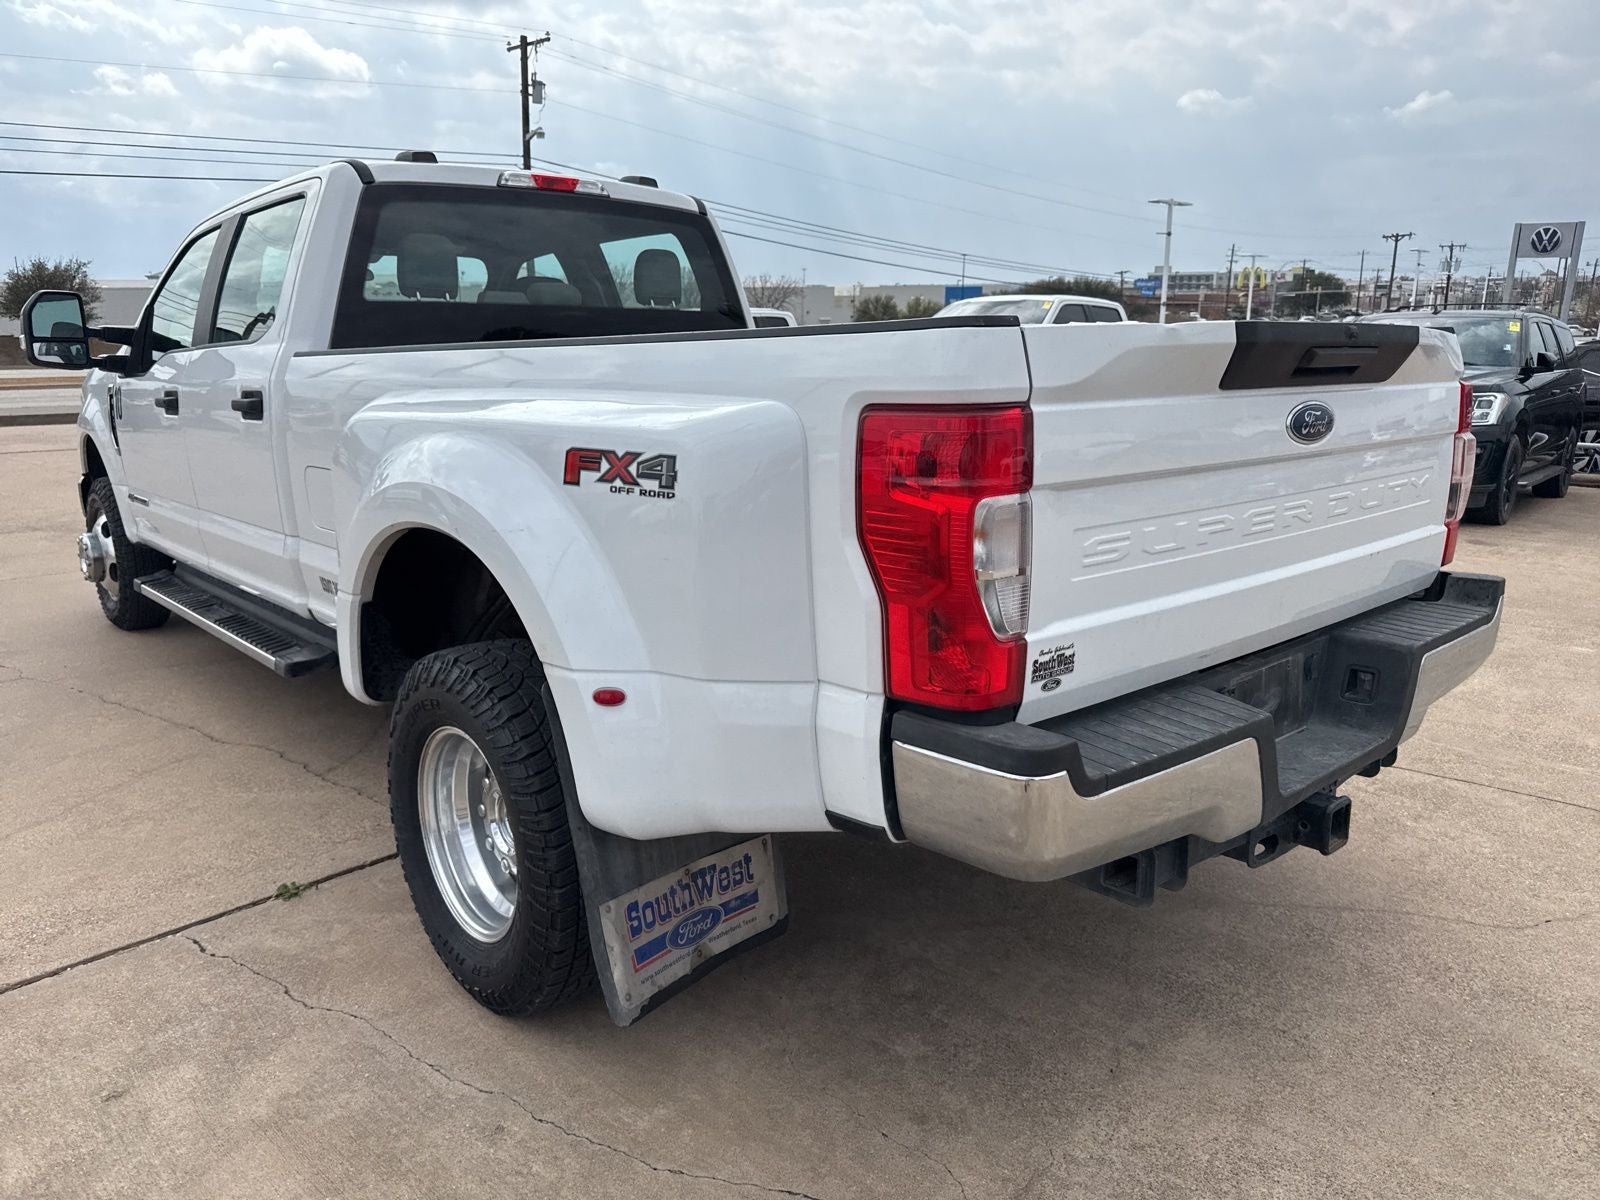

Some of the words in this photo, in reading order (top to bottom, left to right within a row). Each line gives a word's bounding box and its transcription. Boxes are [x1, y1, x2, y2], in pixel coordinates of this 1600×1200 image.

[1301, 410, 1328, 434] Ford
[563, 447, 677, 490] FX4
[609, 485, 635, 496] OFF
[639, 488, 676, 499] ROAD
[1082, 499, 1313, 568] SUPER
[1327, 473, 1430, 518] DUTY
[1032, 651, 1074, 674] SouthWest
[626, 853, 754, 942] SouthWest
[677, 912, 714, 945] Ford
